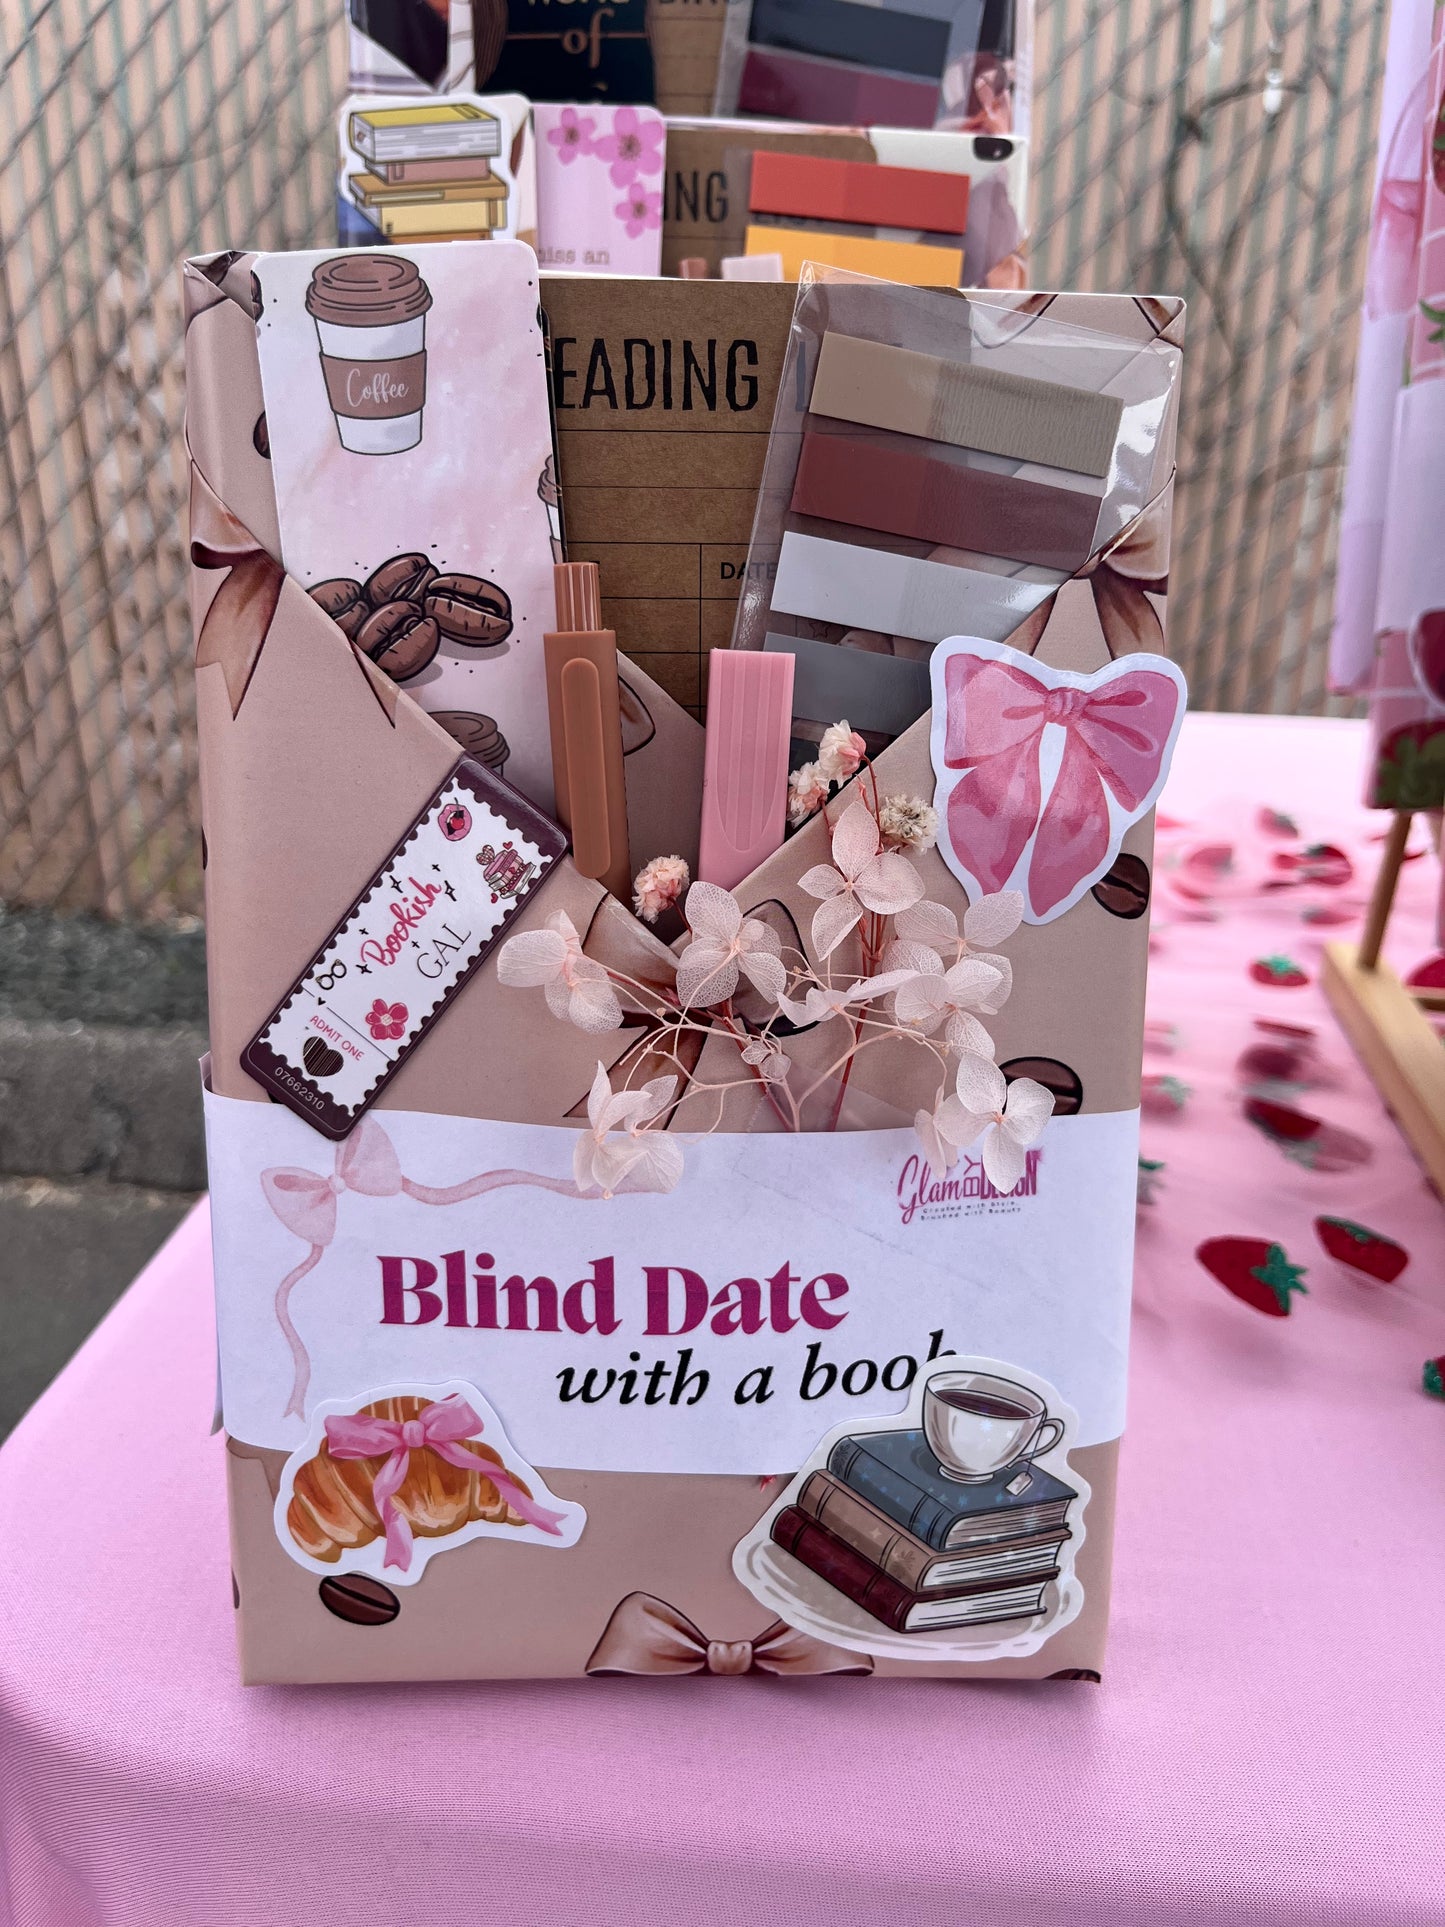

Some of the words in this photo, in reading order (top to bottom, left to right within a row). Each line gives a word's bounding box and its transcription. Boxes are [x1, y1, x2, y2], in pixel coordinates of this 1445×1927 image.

[562, 8, 615, 69] of
[347, 368, 409, 408] Coffee
[554, 337, 759, 412] EADING
[361, 876, 442, 967] Bookish
[417, 923, 472, 979] GAL
[310, 1015, 343, 1043] ADMIT
[341, 1040, 365, 1061] ONE
[274, 1066, 325, 1110] 07662310
[898, 1154, 962, 1225] Glam
[377, 1249, 623, 1335] Blind
[642, 1260, 850, 1336] Date
[556, 1348, 709, 1406] with
[734, 1366, 774, 1405] a
